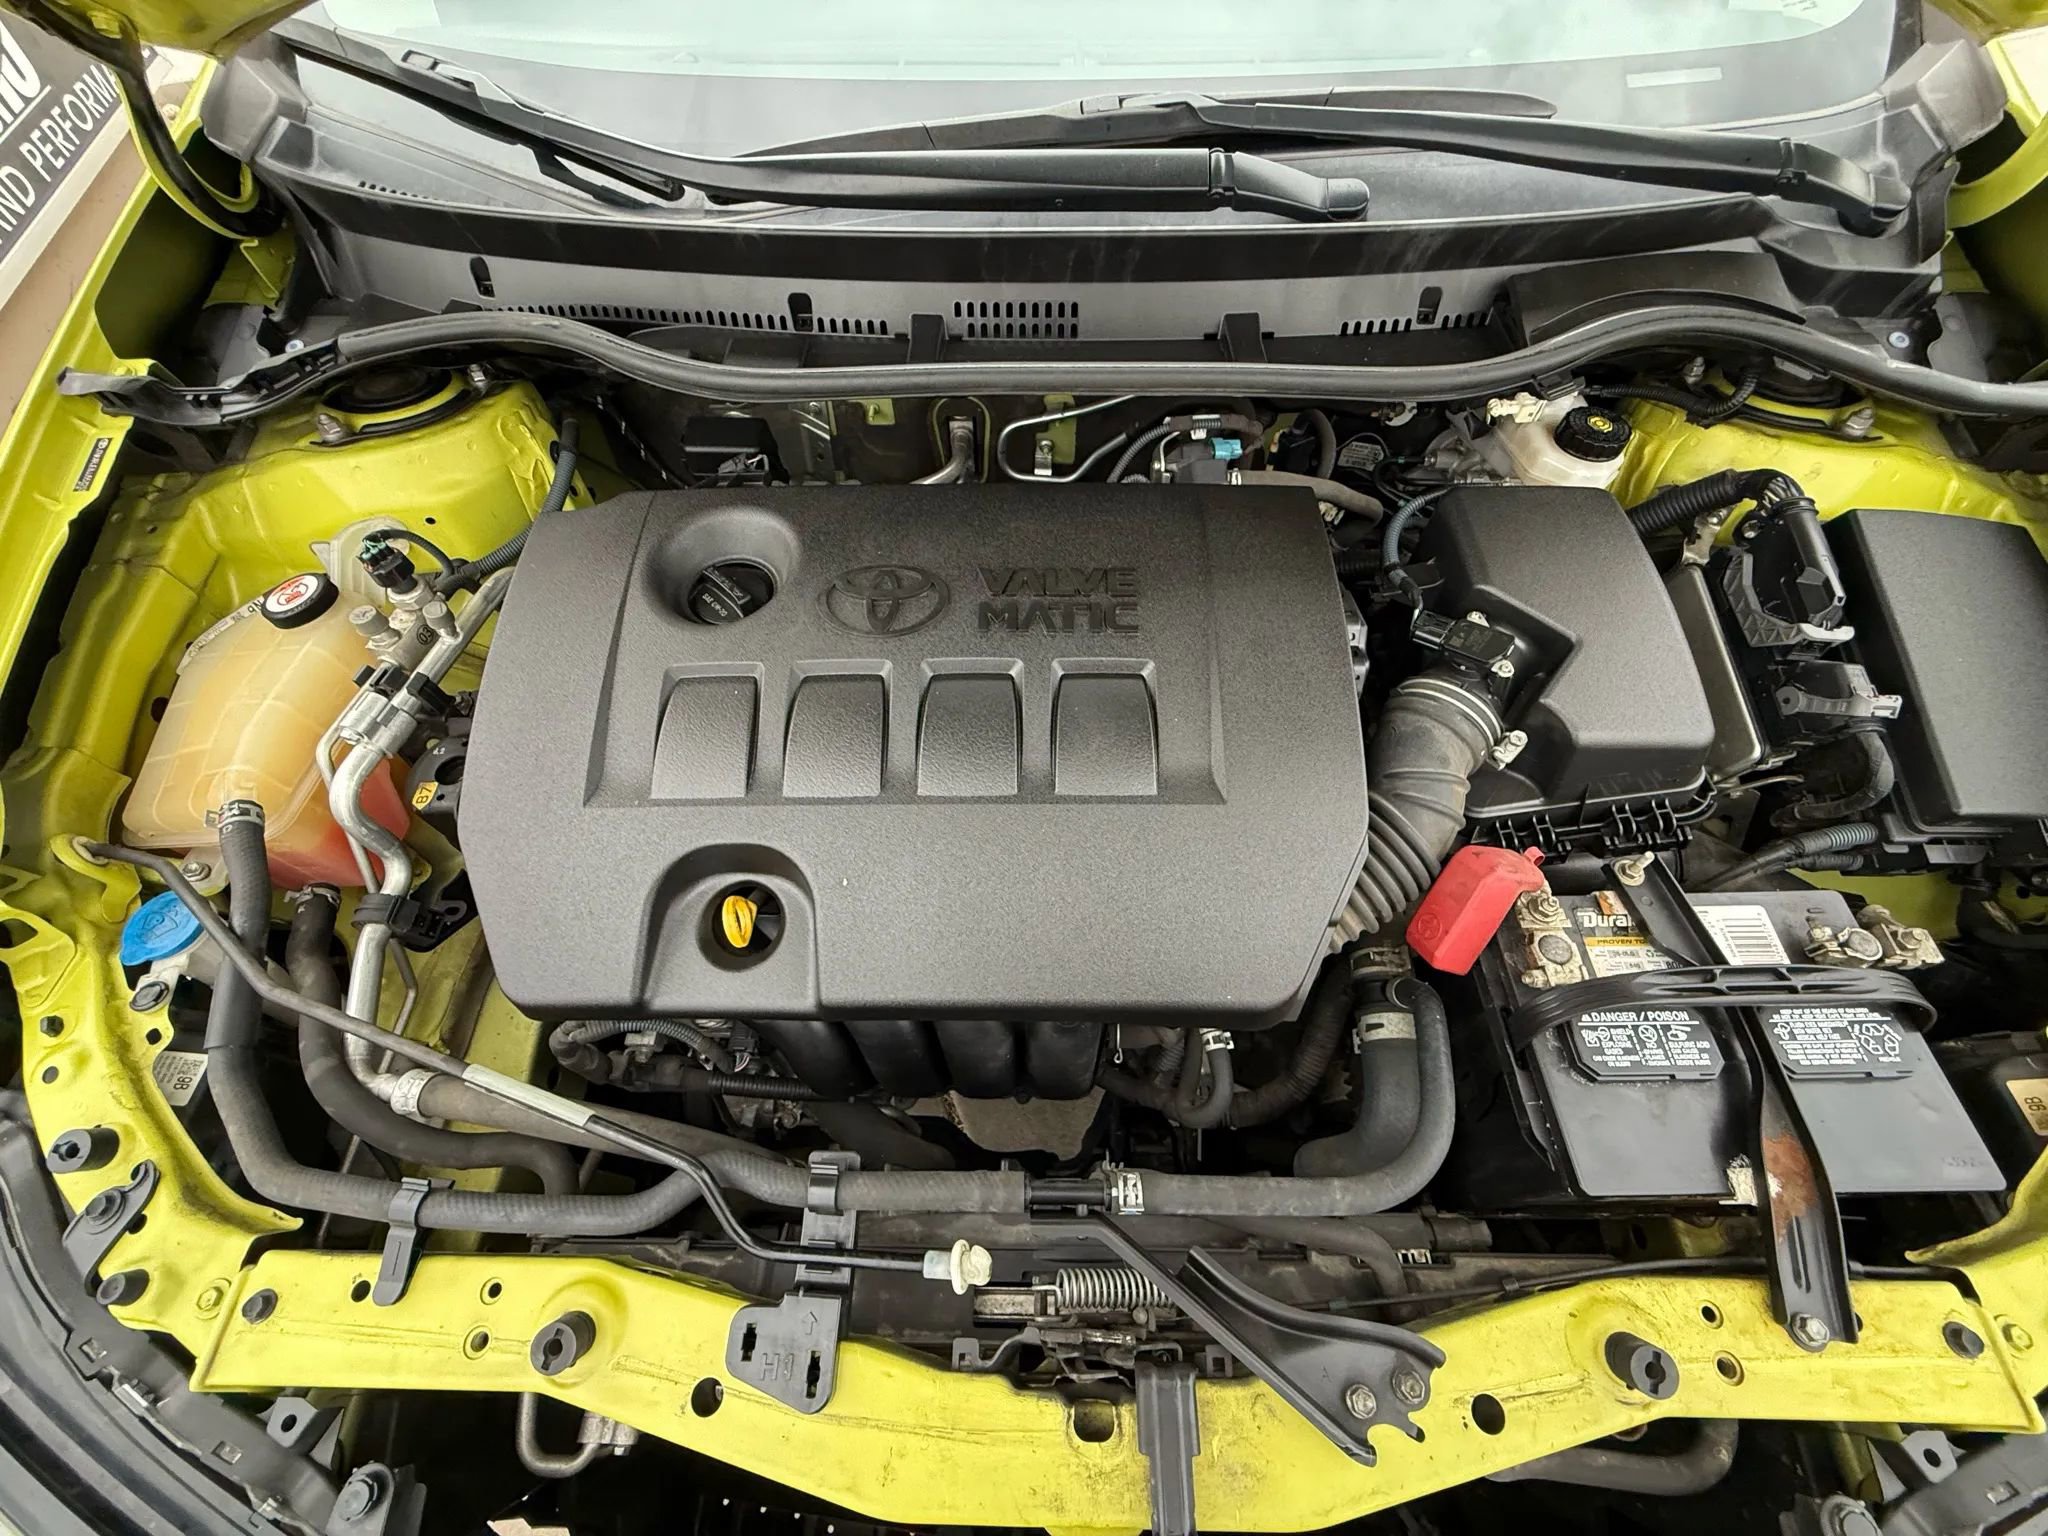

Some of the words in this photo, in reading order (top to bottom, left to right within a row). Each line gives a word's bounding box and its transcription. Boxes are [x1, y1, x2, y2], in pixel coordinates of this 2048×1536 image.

[0, 166, 36, 231] ND
[977, 567, 1137, 598] VALVE
[978, 601, 1139, 634] MATIC
[1577, 912, 1635, 928] Dural
[1591, 1012, 1637, 1021] DANGER
[1647, 1011, 1689, 1021] POISON
